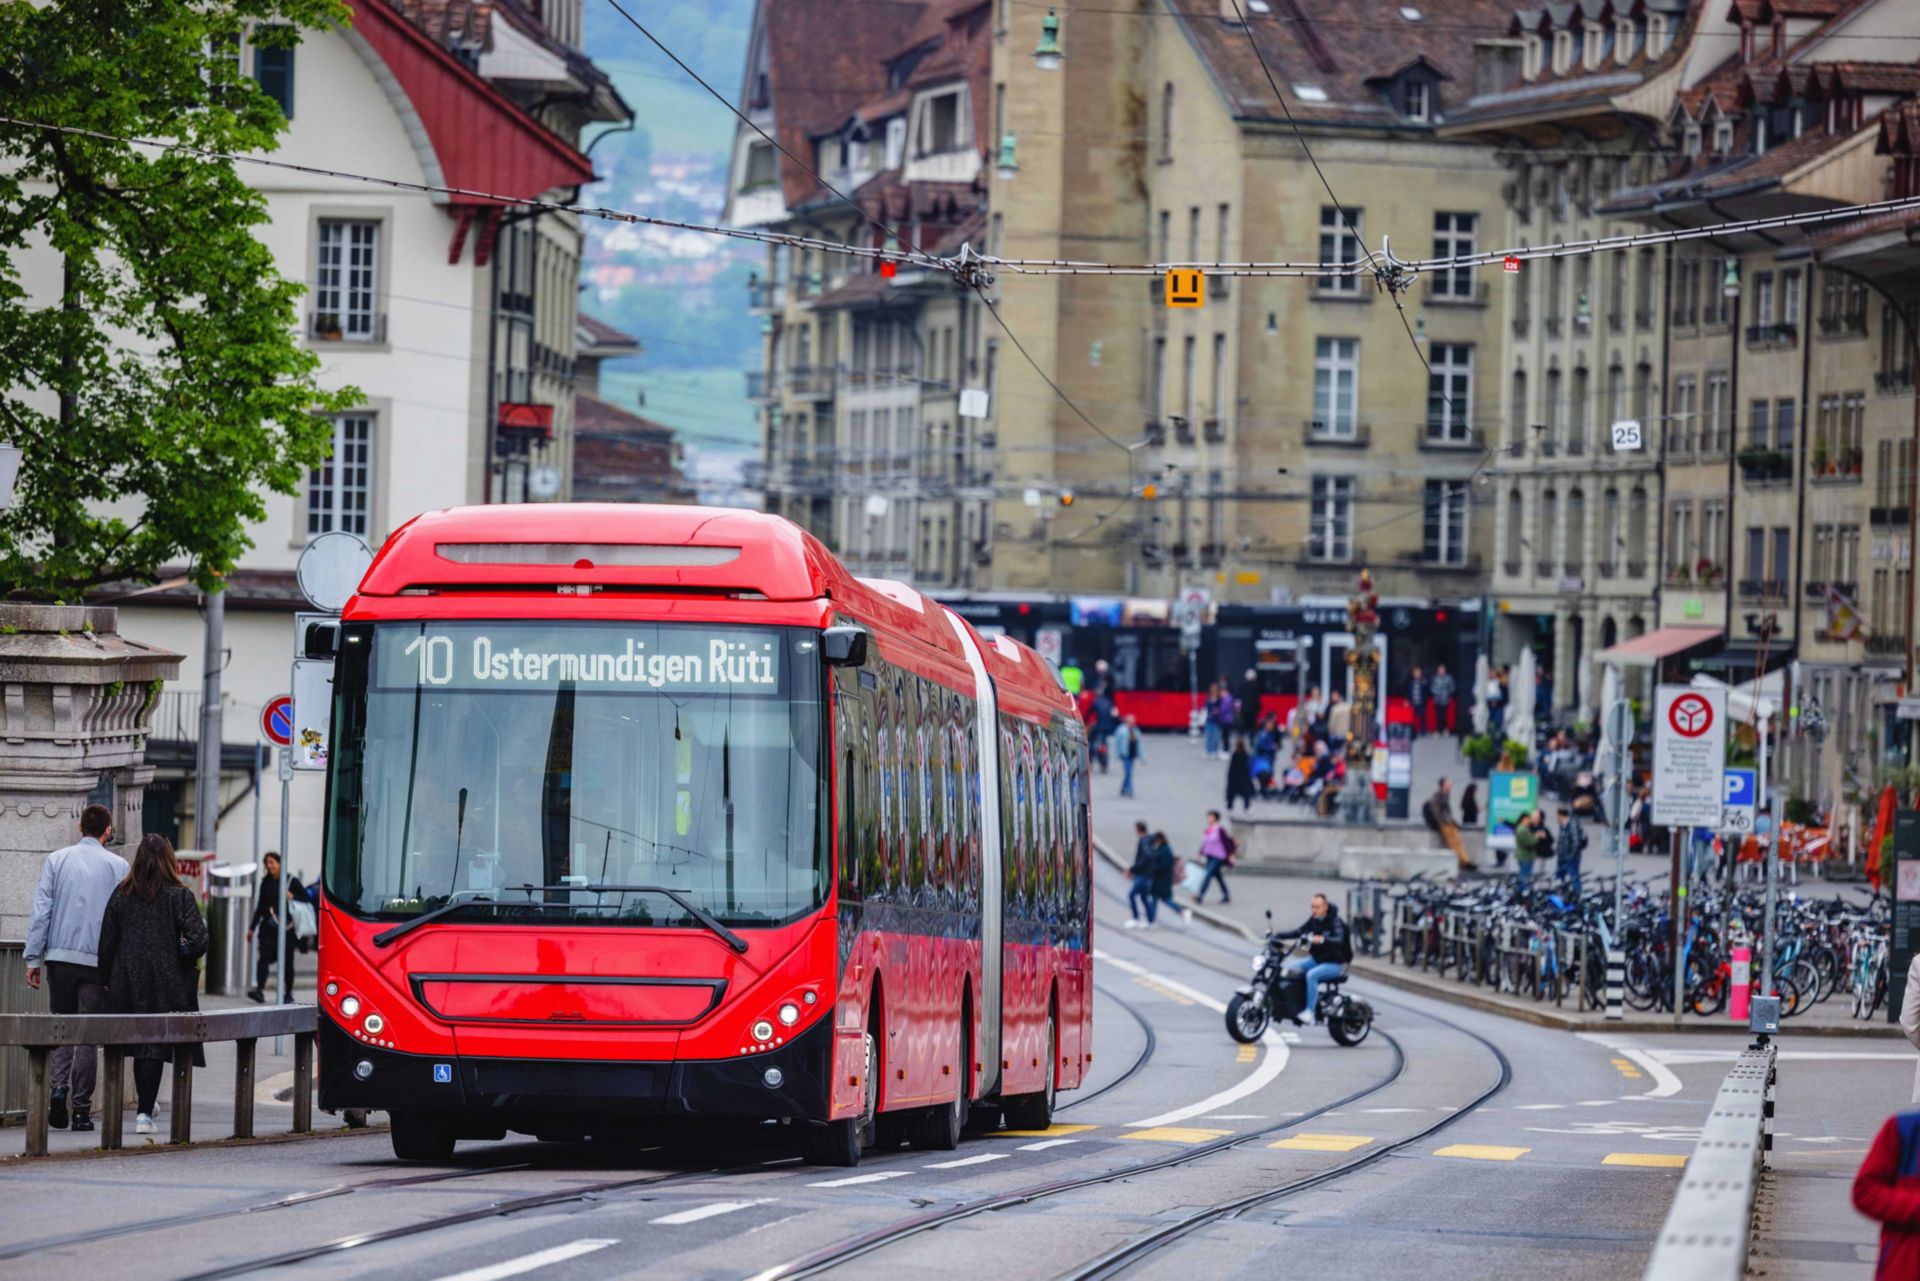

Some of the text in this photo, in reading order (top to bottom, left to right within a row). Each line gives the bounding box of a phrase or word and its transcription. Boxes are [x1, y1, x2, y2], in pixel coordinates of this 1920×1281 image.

[1615, 427, 1639, 444] 25
[405, 635, 774, 688] 10 Ostermundigen Rüti
[1724, 775, 1745, 803] P
